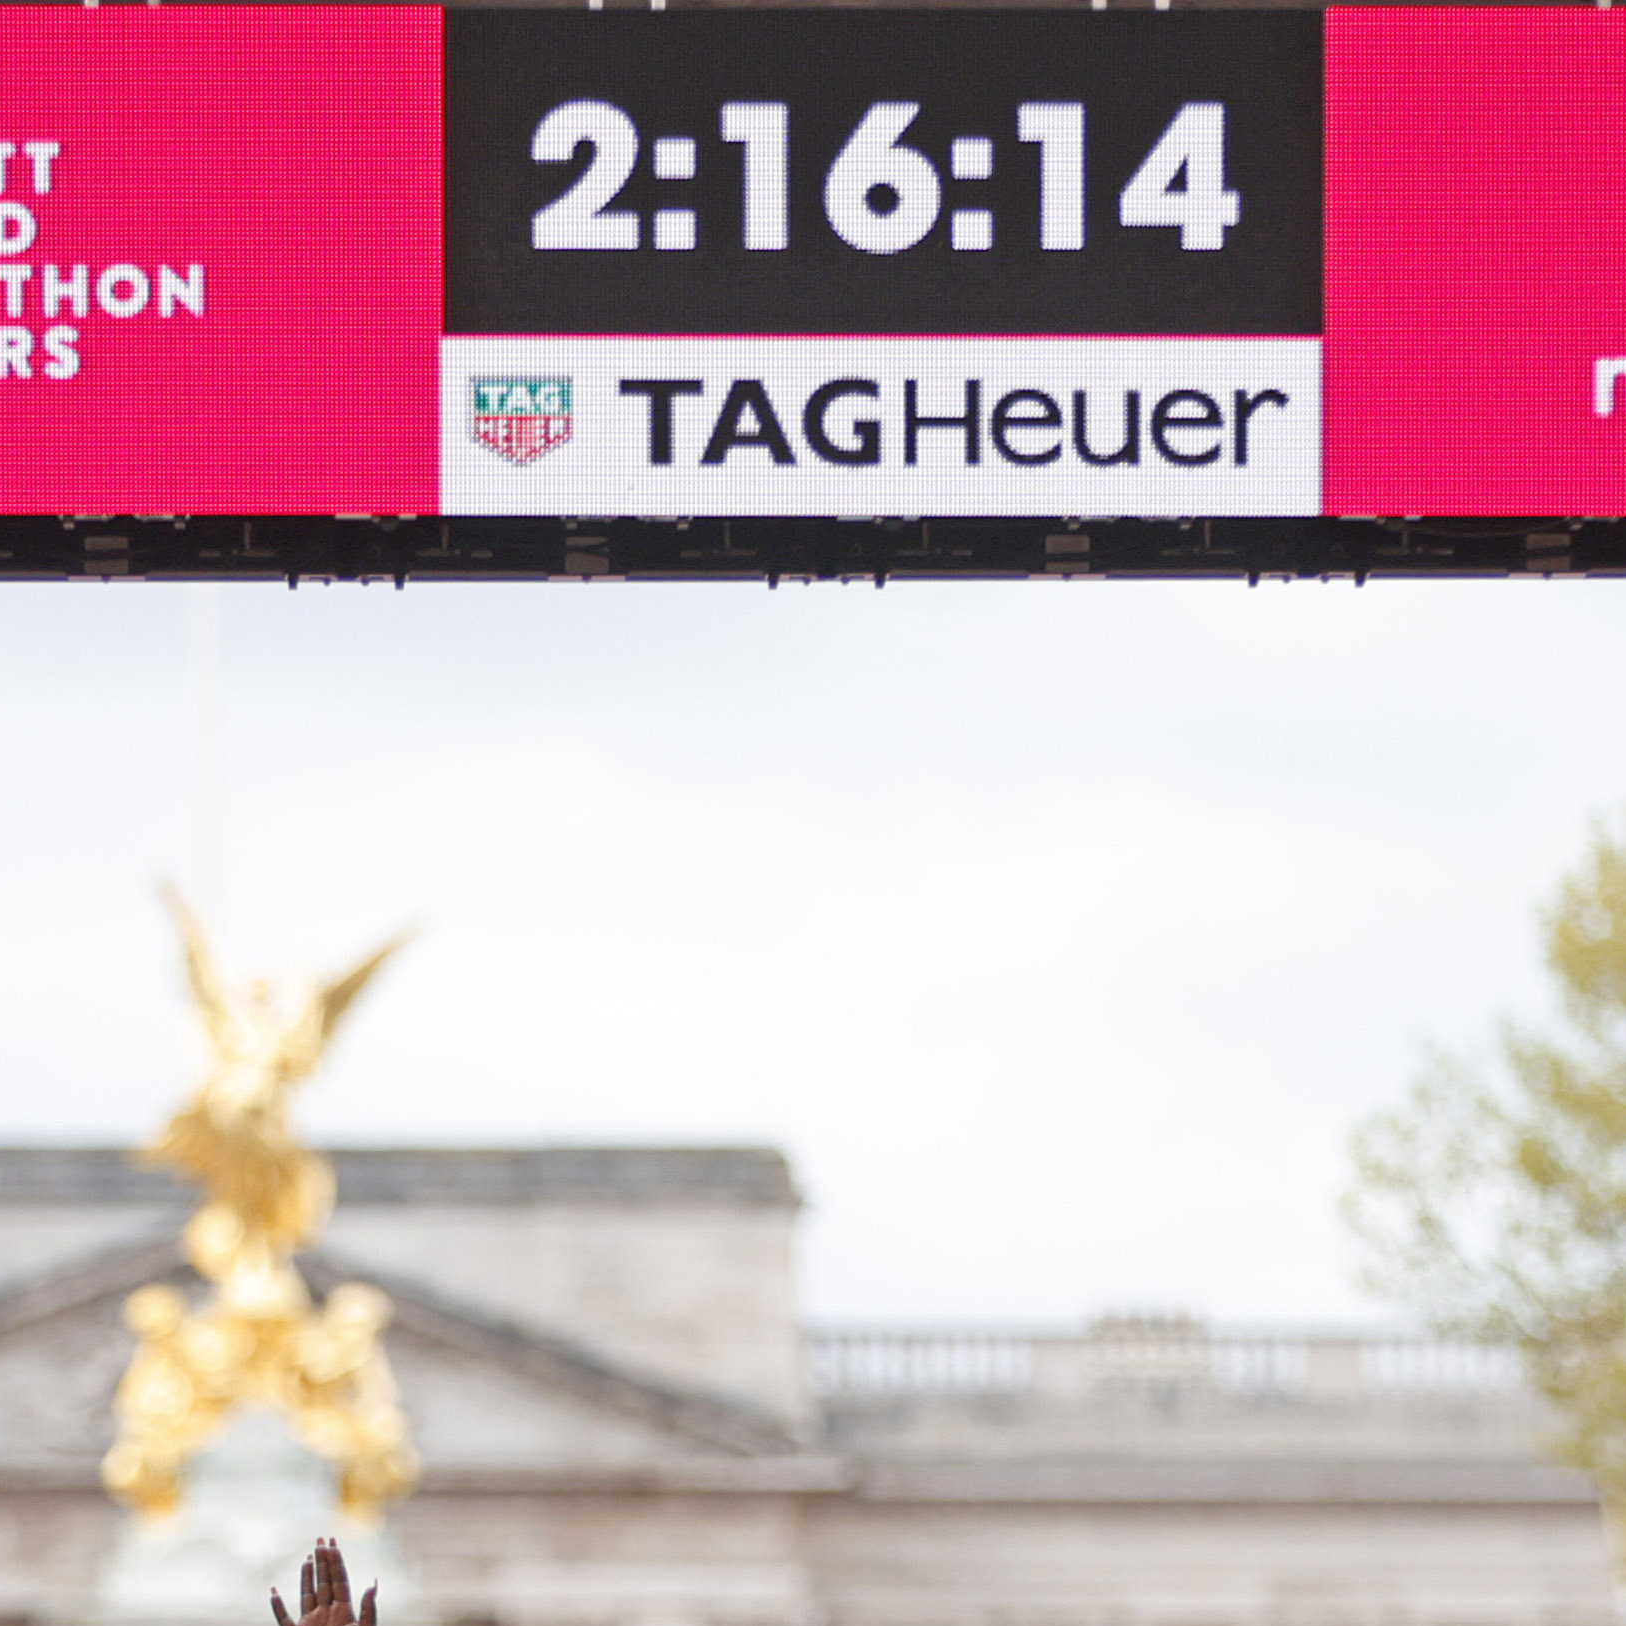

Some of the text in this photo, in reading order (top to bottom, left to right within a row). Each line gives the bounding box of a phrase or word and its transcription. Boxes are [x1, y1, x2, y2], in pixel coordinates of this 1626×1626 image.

[531, 99, 1240, 255] 2:16:14
[479, 384, 562, 413] TAG
[618, 377, 1289, 468] TAGHeuer
